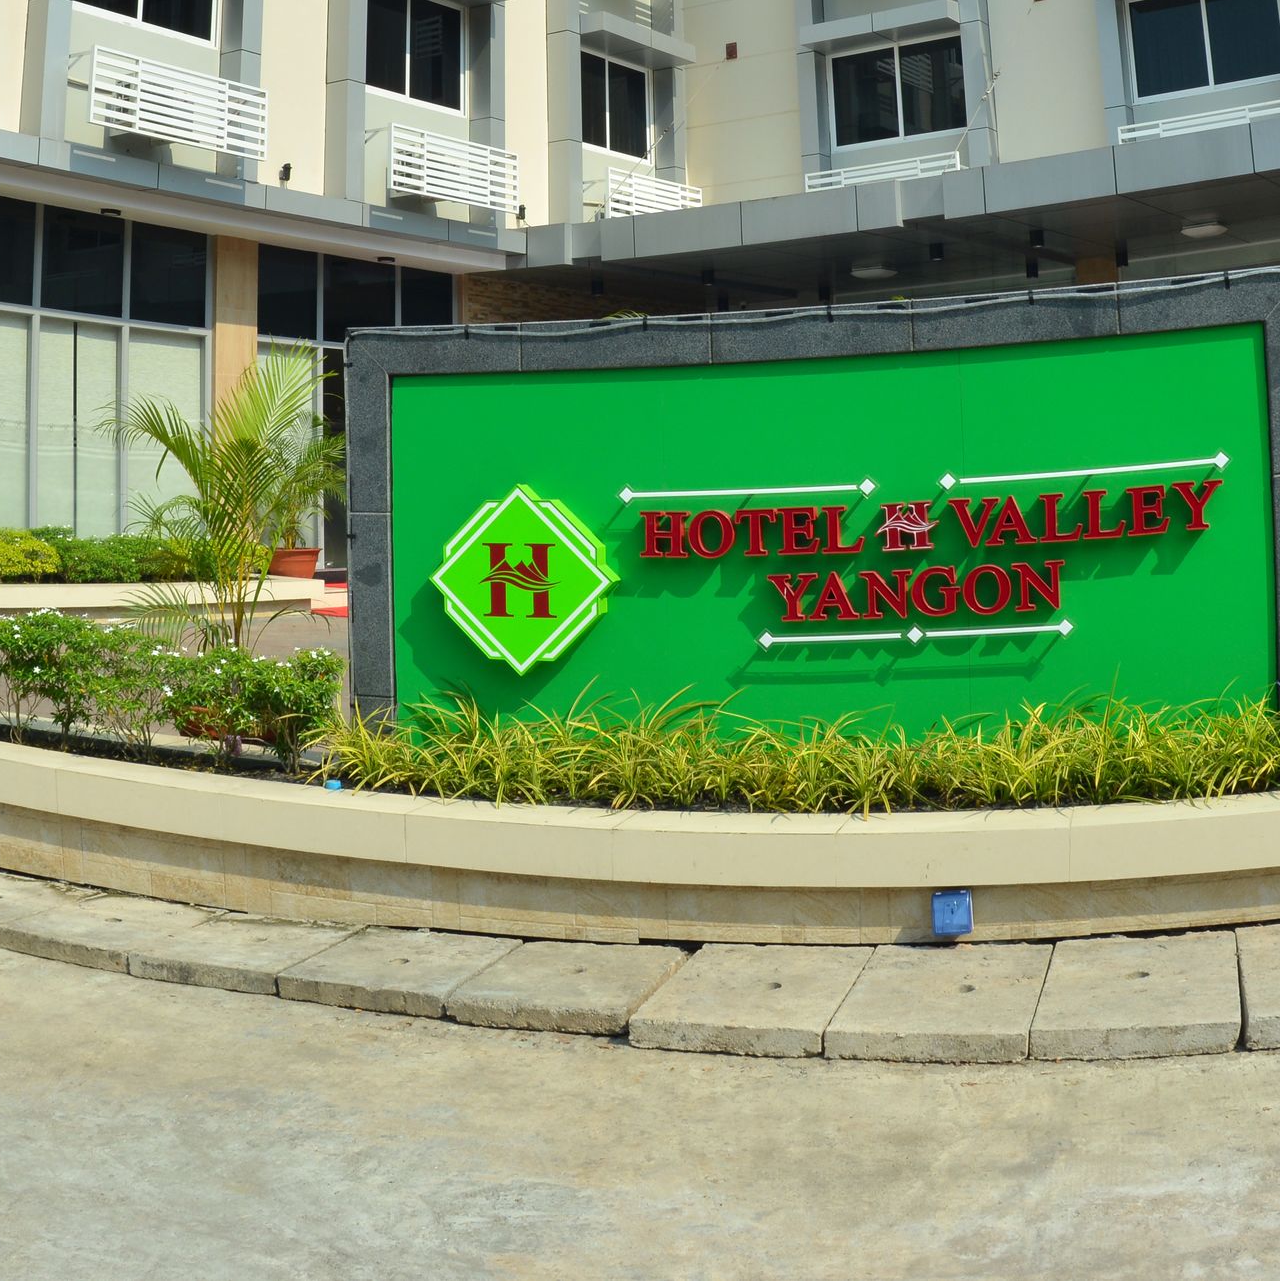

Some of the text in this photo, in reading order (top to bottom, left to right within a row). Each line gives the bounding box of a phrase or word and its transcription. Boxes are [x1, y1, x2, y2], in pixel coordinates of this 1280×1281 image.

[639, 505, 865, 559] HOTEL
[947, 479, 1224, 549] VALLEY
[766, 560, 1066, 622] YANGON
